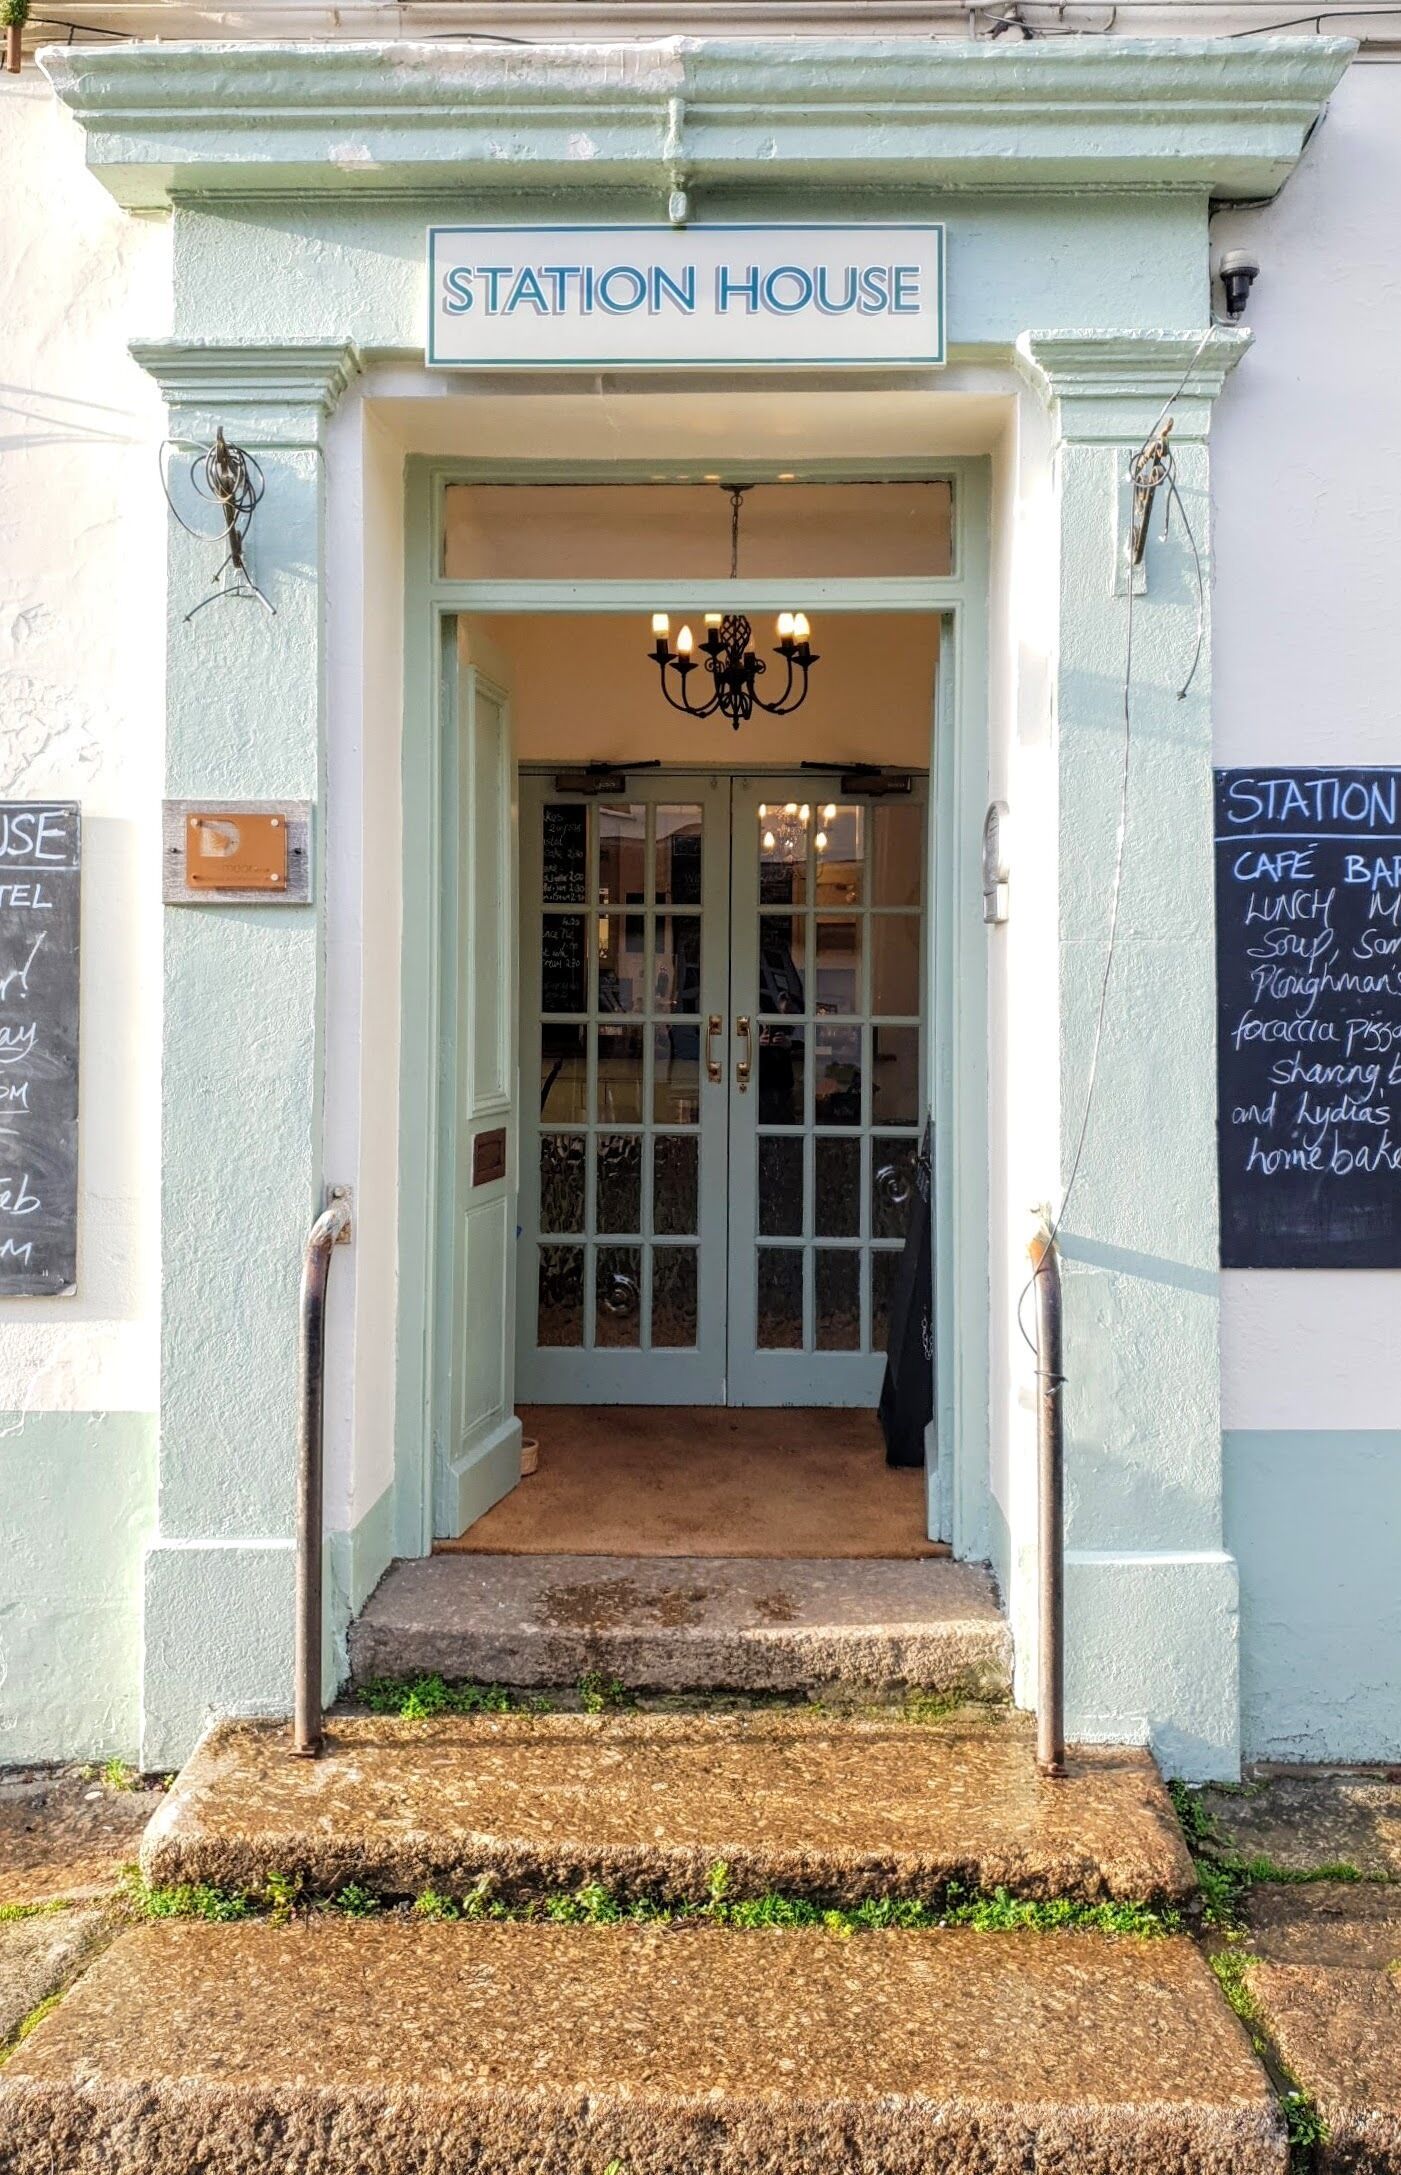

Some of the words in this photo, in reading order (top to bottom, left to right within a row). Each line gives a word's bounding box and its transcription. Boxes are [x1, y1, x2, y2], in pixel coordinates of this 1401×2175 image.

[443, 265, 696, 316] STATION
[715, 264, 922, 316] HOUSE
[1227, 777, 1397, 827] STATION
[1233, 843, 1319, 883] CAFÉ
[1245, 888, 1336, 928] LUNCH
[1246, 927, 1339, 972] Soup,
[1231, 1009, 1341, 1052] focaccia
[1267, 1051, 1381, 1105] sharing
[1231, 1090, 1277, 1126] and
[0, 1174, 41, 1215] eb
